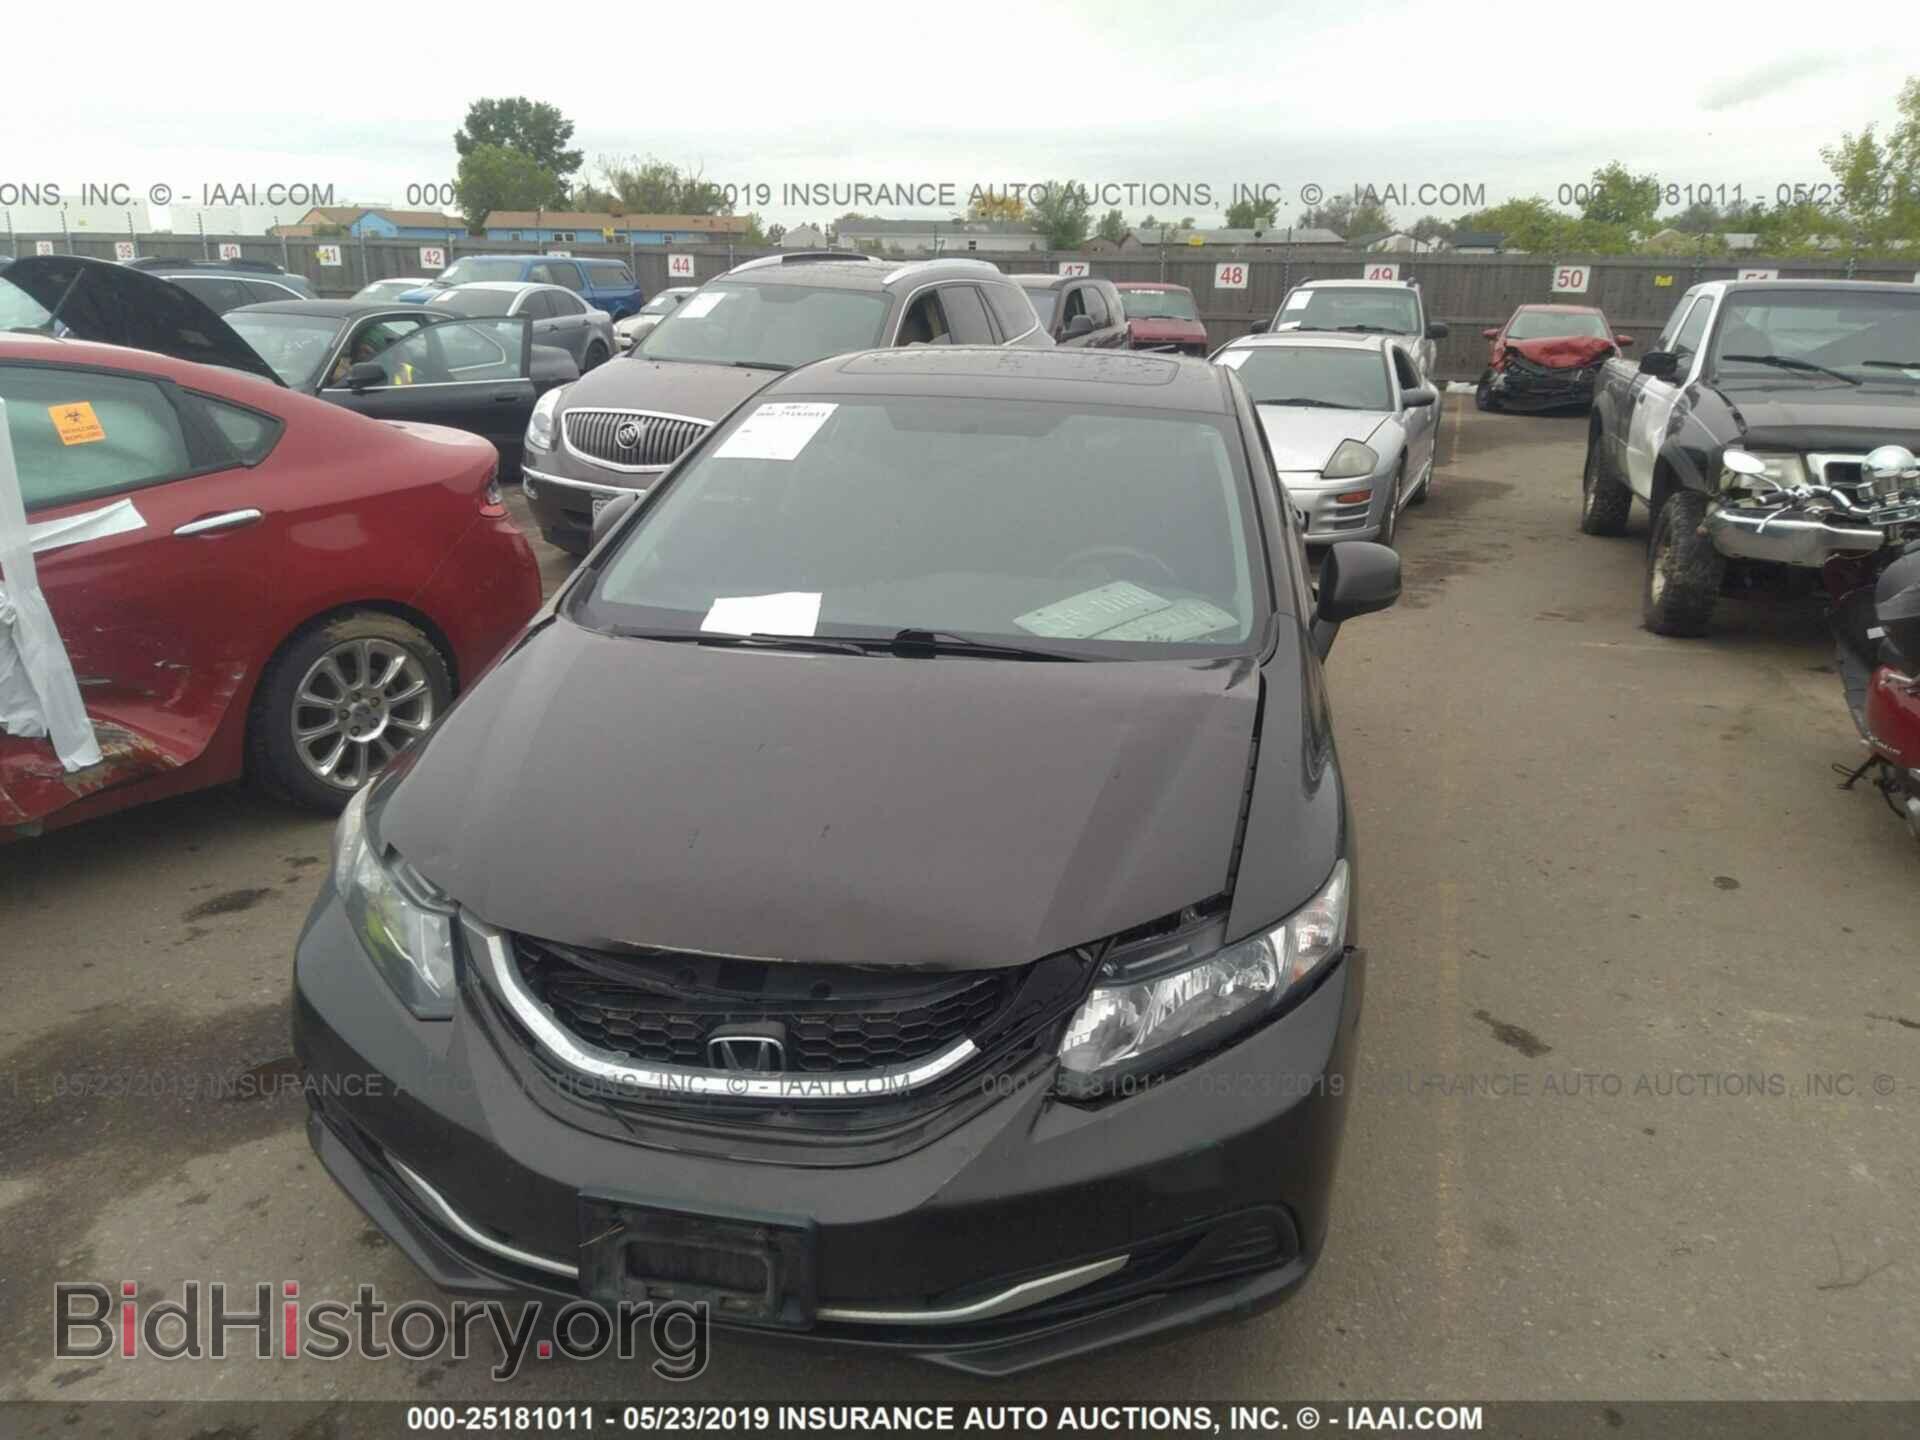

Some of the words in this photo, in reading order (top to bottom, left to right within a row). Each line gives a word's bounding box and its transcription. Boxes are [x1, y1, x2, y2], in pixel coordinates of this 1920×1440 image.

[424, 250, 441, 265] 42
[672, 257, 689, 273] 44
[1220, 266, 1243, 284] 48
[1370, 267, 1393, 280] 49
[1557, 269, 1583, 288] 50
